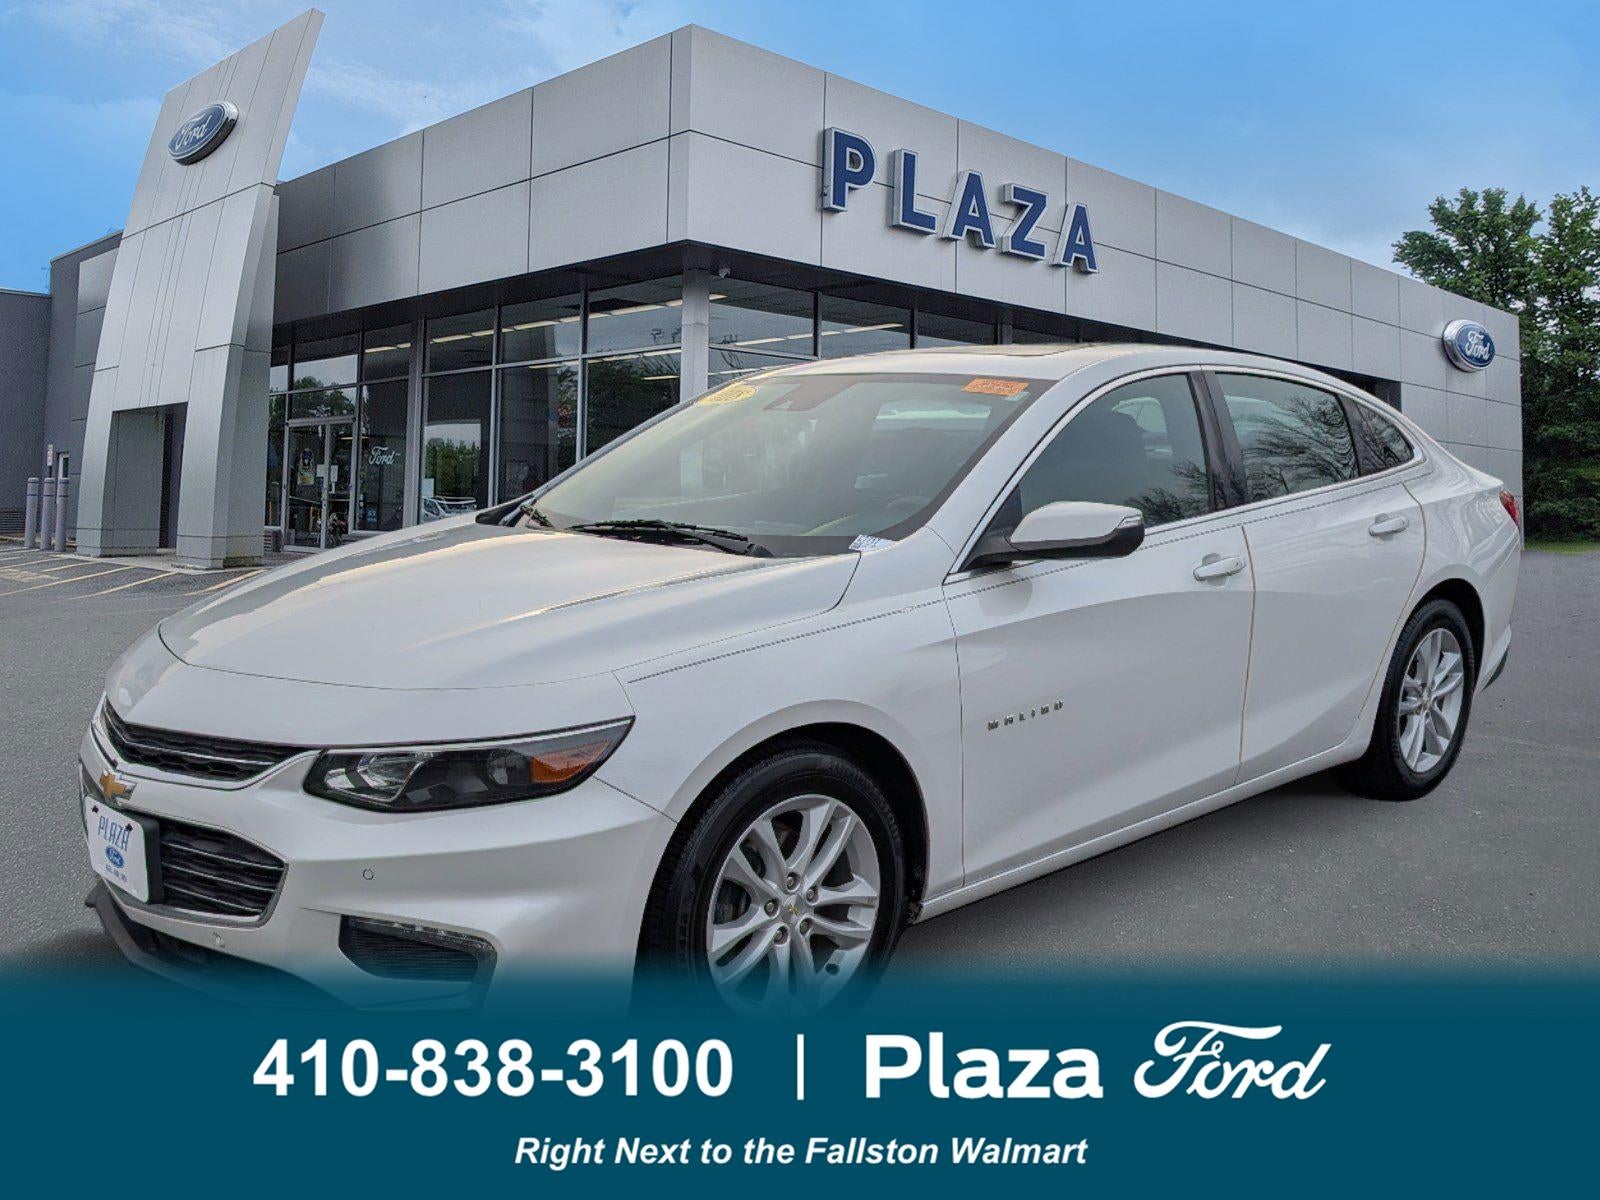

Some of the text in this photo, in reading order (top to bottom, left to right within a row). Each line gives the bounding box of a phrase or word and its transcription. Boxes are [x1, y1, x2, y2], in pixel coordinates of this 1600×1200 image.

[174, 113, 213, 151] Ford
[822, 126, 1099, 274] PLAZA
[1465, 330, 1491, 361] Ford
[368, 445, 396, 465] Ford
[98, 815, 130, 852] PLAZA
